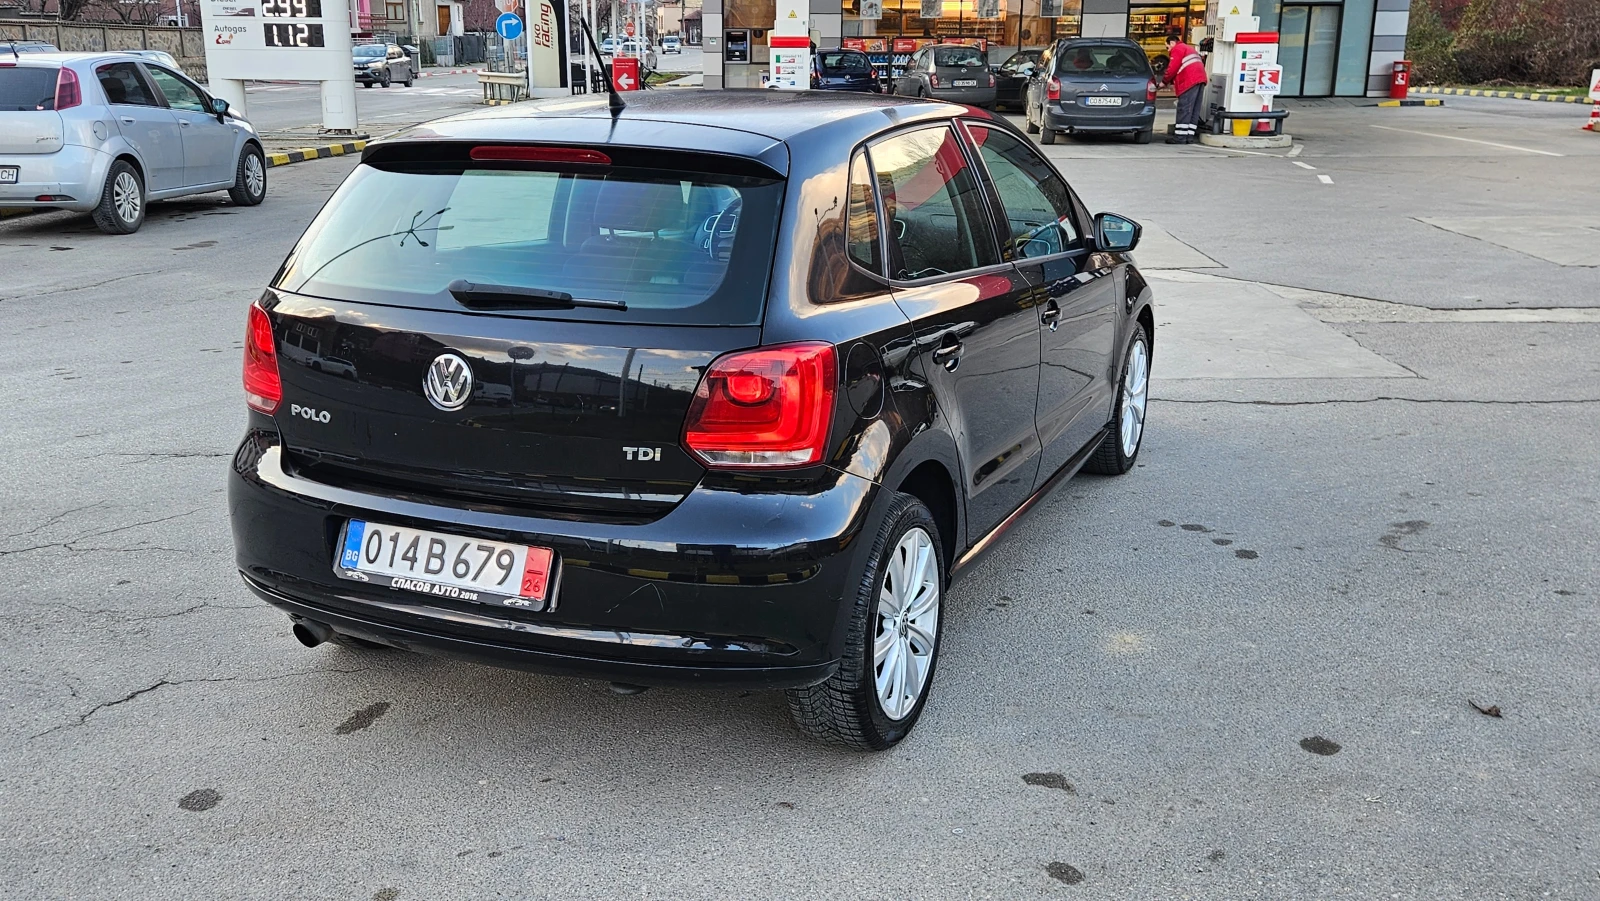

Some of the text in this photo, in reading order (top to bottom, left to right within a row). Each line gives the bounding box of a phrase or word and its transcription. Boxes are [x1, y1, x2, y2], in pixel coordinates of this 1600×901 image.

[262, 0, 307, 17] 2.99
[214, 25, 247, 34] Autogas
[272, 24, 309, 47] 1.12
[534, 23, 542, 46] EKO
[540, 2, 552, 49] racing
[290, 403, 332, 424] POLO
[345, 549, 359, 562] BG
[391, 577, 479, 601] СПАСОВ АУТО 2016
[523, 578, 540, 593] 26
